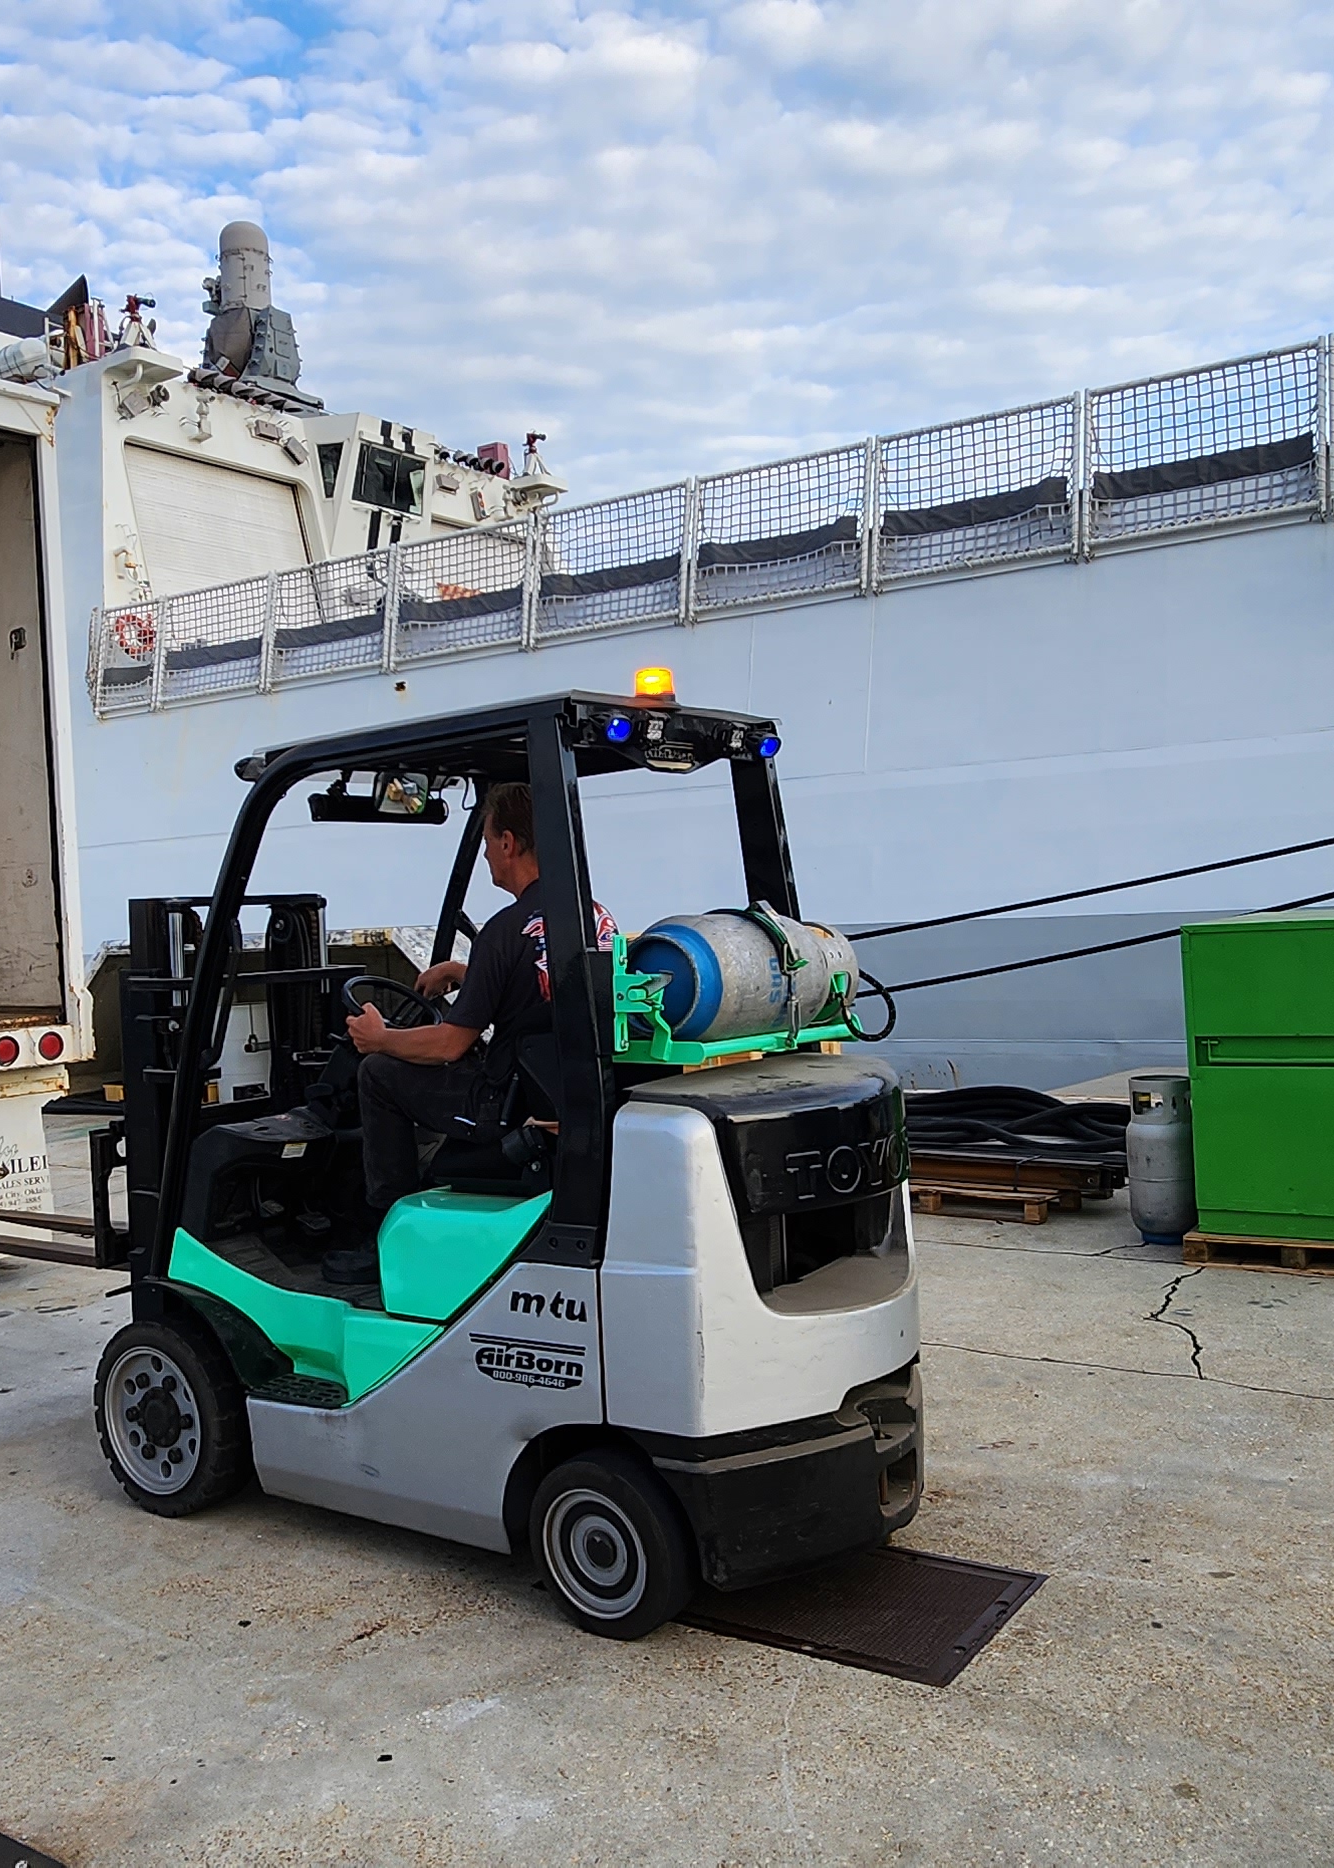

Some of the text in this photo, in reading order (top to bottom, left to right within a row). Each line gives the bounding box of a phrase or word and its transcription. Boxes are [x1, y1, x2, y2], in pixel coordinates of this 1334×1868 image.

[785, 1128, 905, 1199] TOYO
[509, 1290, 588, 1323] mtu
[475, 1347, 584, 1378] AirBorn
